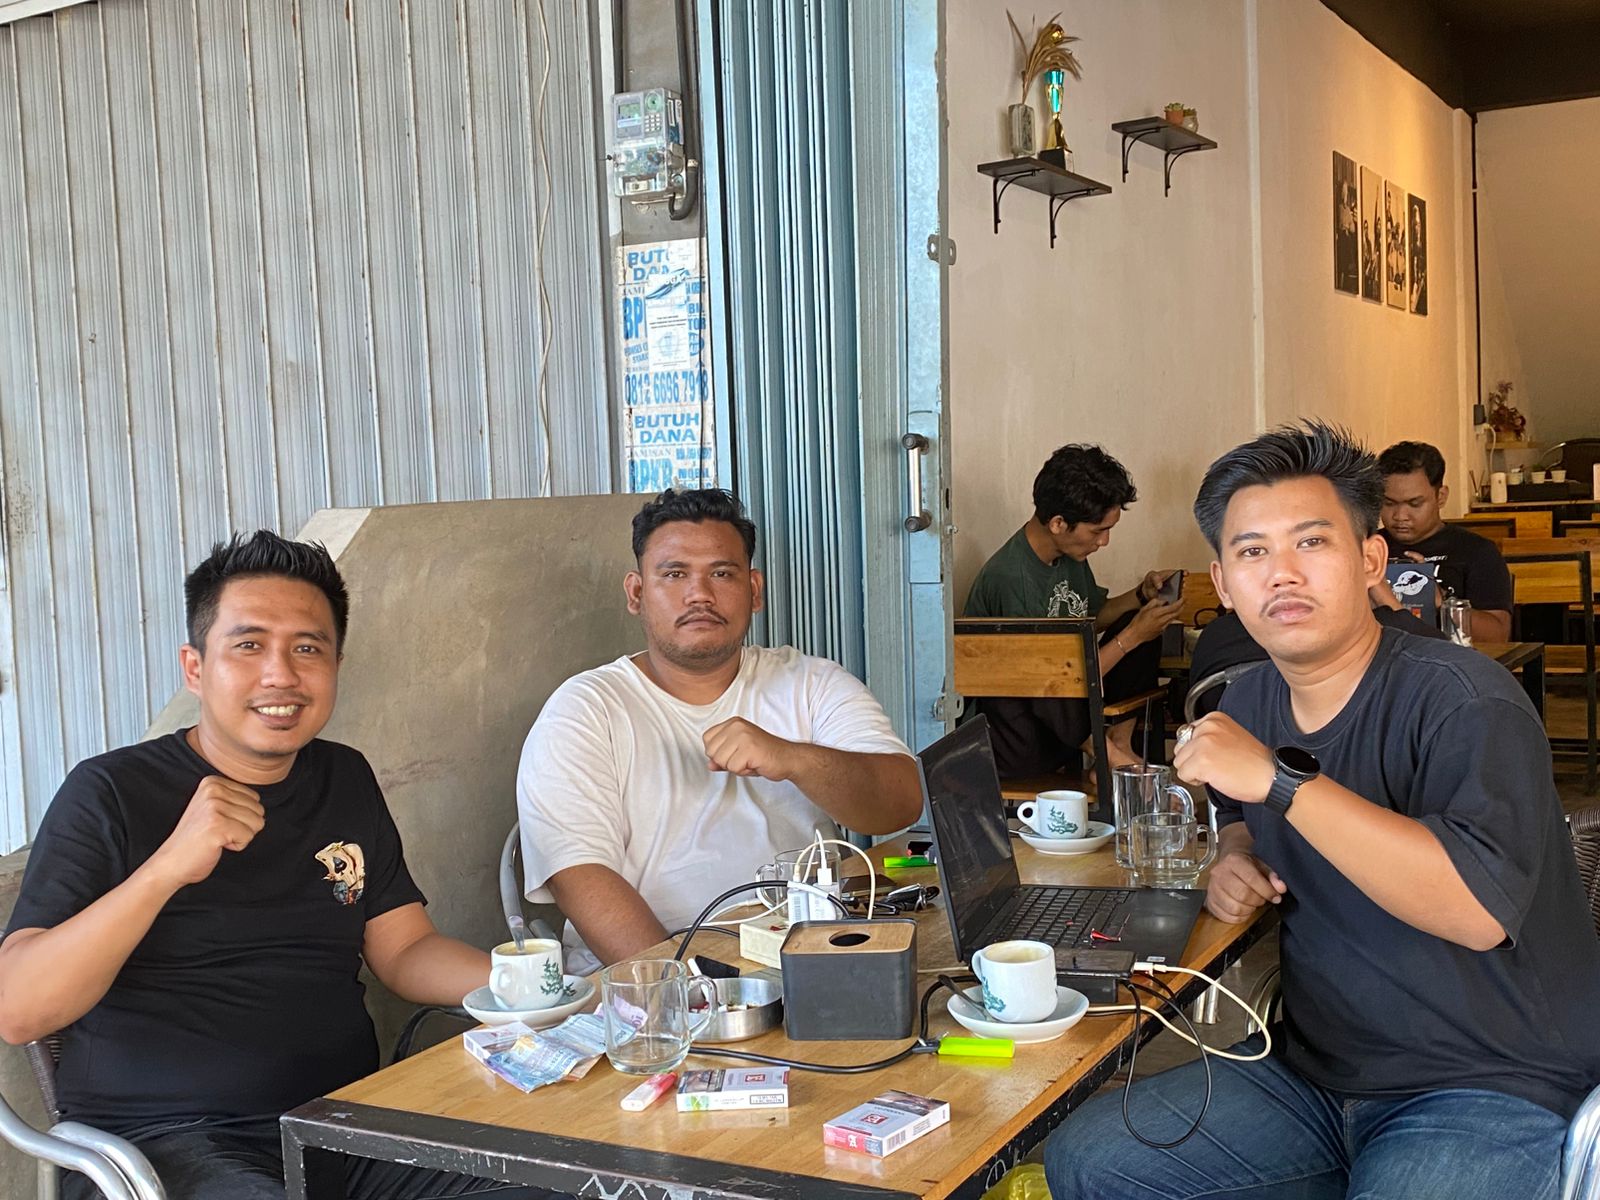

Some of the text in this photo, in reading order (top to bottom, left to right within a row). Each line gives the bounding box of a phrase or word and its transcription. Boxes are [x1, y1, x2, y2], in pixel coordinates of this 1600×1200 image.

[625, 373, 651, 405] 0812
[634, 413, 699, 428] BUTUH
[640, 428, 696, 443] DANA
